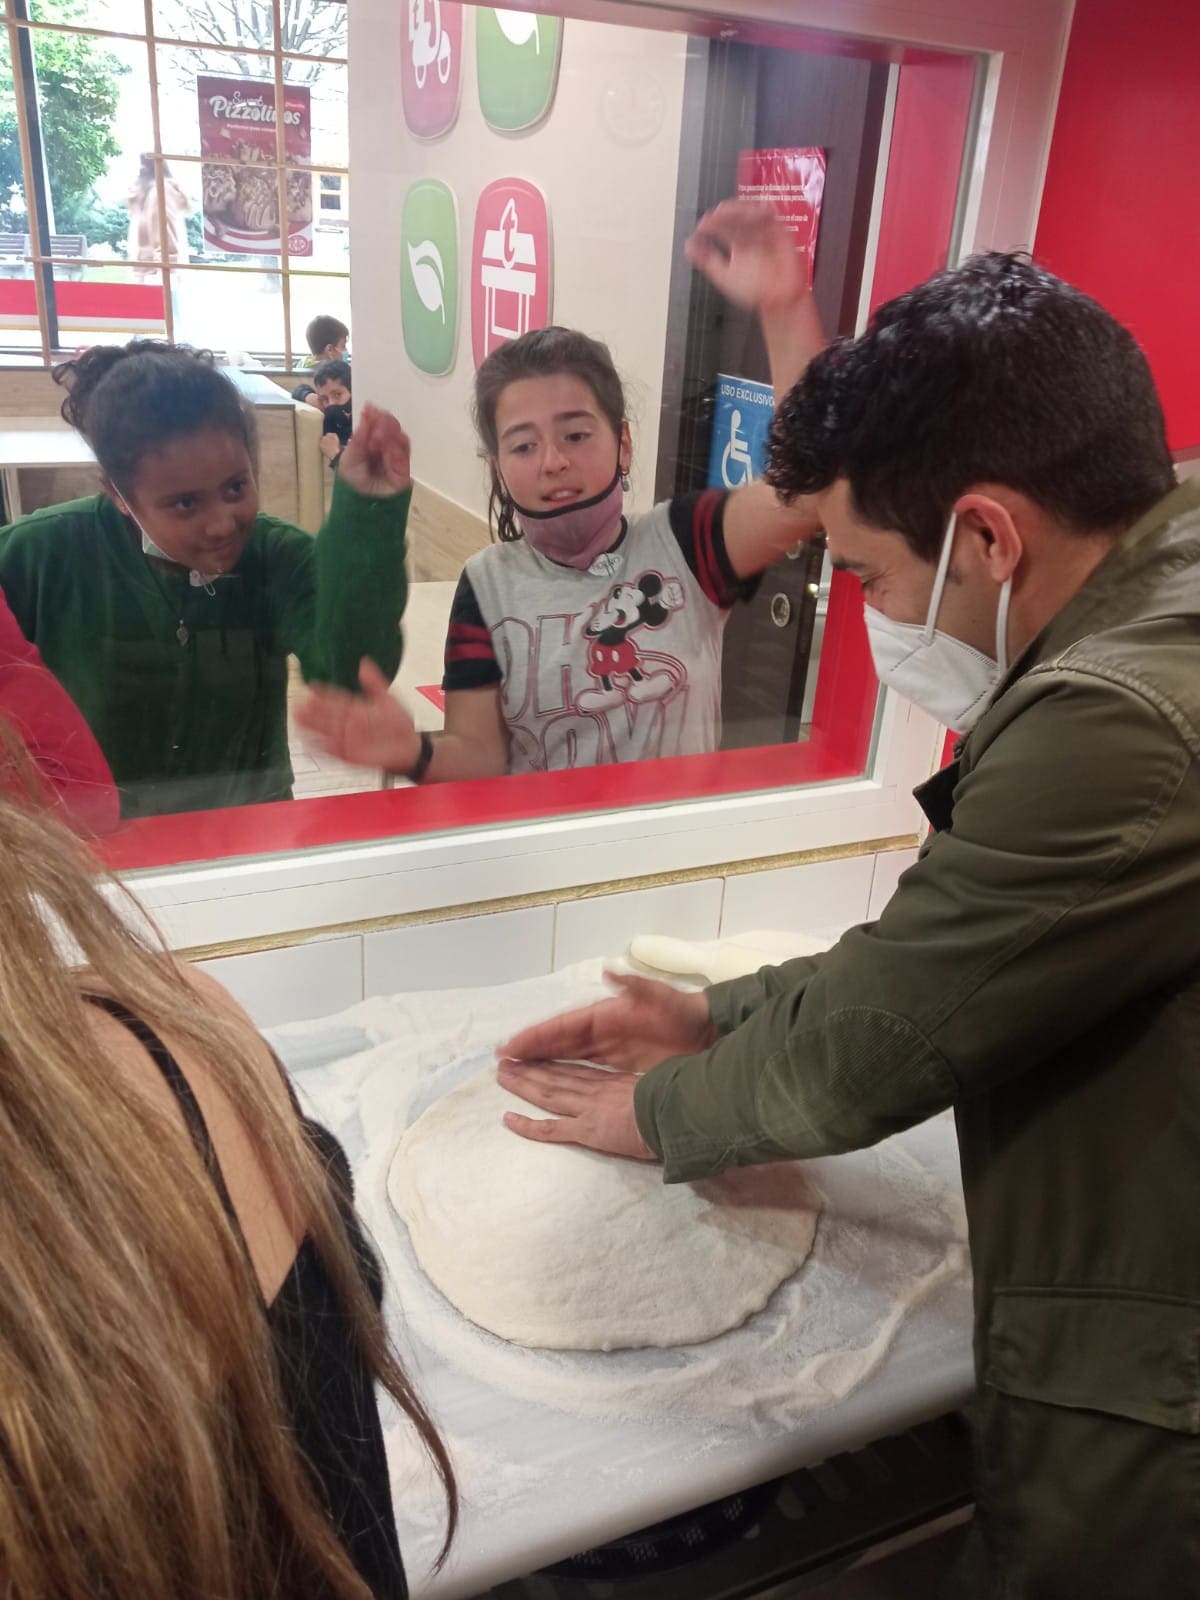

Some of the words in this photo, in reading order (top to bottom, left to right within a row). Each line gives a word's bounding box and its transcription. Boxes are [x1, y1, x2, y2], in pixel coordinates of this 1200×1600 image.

[209, 95, 301, 125] Pizzolios
[721, 384, 736, 397] USO
[736, 388, 775, 407] EXCLUSIVO
